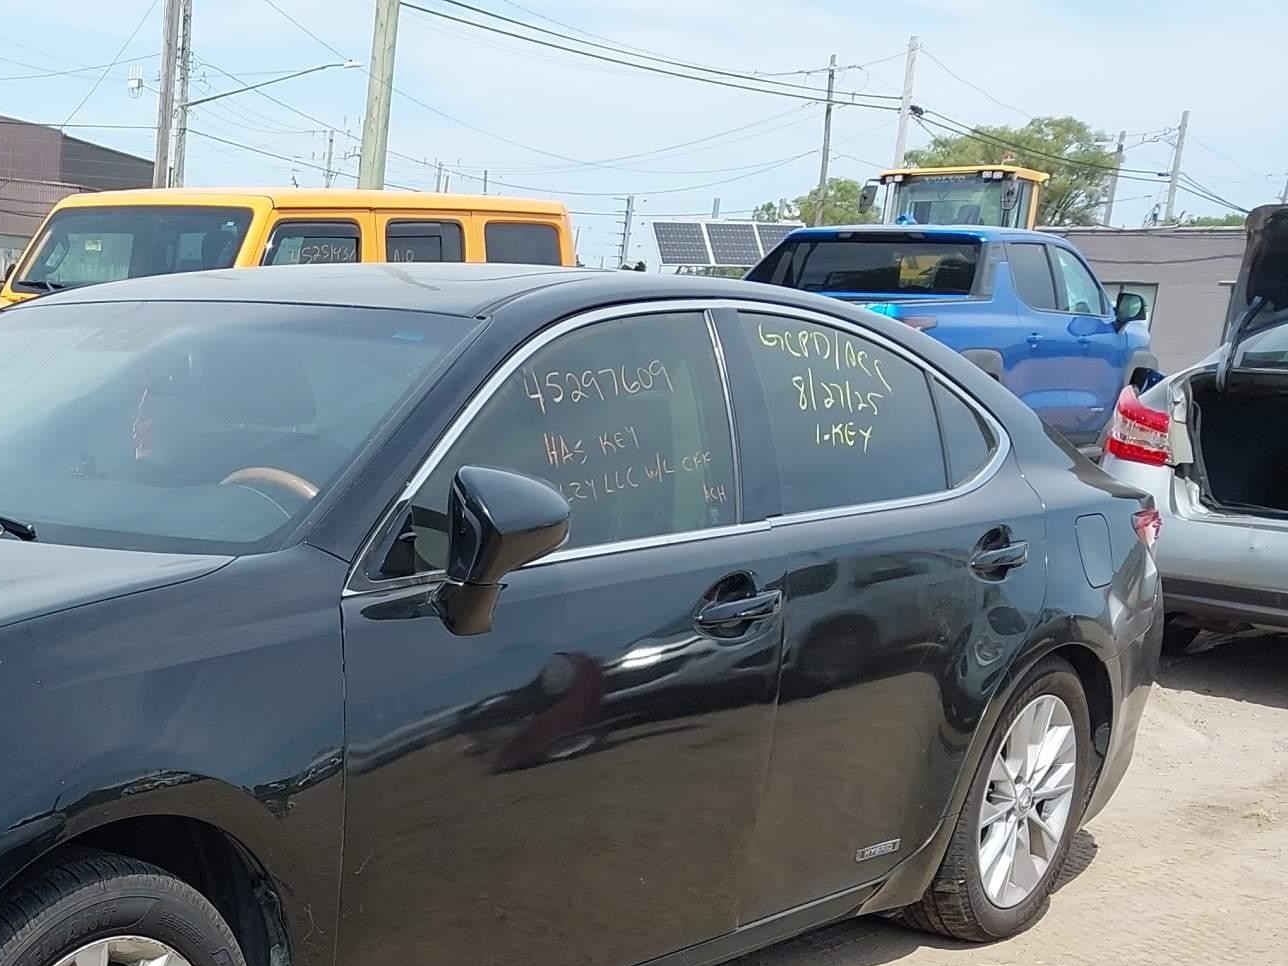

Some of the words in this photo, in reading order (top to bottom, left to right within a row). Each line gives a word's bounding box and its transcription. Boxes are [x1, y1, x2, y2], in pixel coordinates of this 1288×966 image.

[522, 359, 674, 414] 45297609
[792, 367, 883, 415] 8/27/25
[543, 433, 588, 467] HAS
[598, 426, 640, 456] KEY
